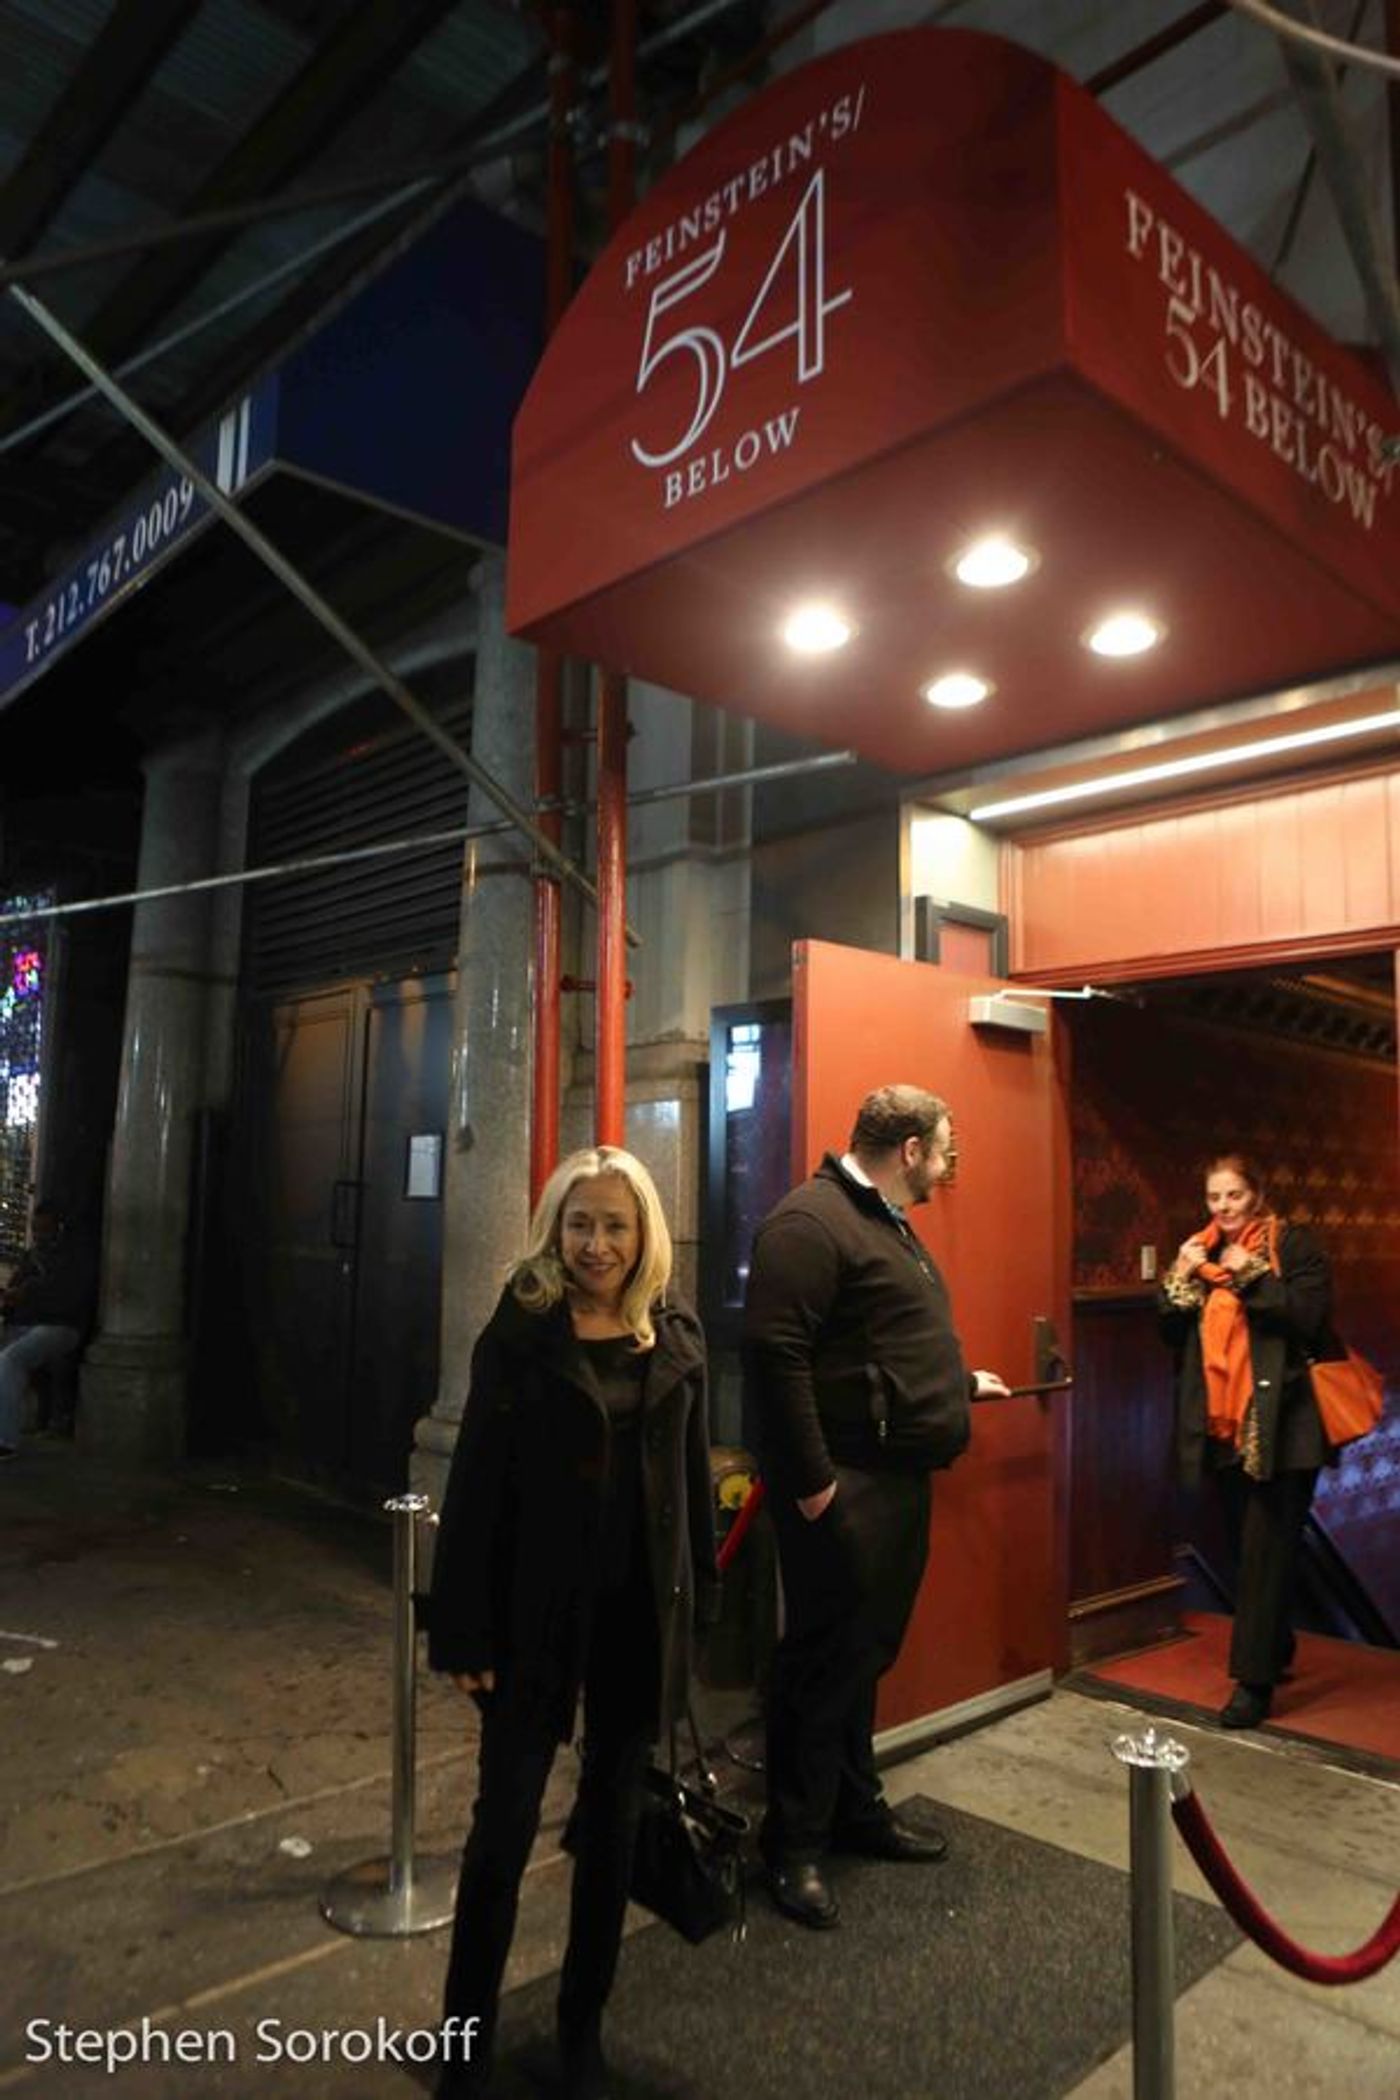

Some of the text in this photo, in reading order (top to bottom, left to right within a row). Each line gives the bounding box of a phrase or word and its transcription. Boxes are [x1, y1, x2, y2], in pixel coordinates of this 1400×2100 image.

[625, 84, 865, 288] FEINSTEIN'S/
[631, 168, 853, 467] 54
[1165, 297, 1378, 530] 54 BELOW
[664, 407, 800, 508] BELOW
